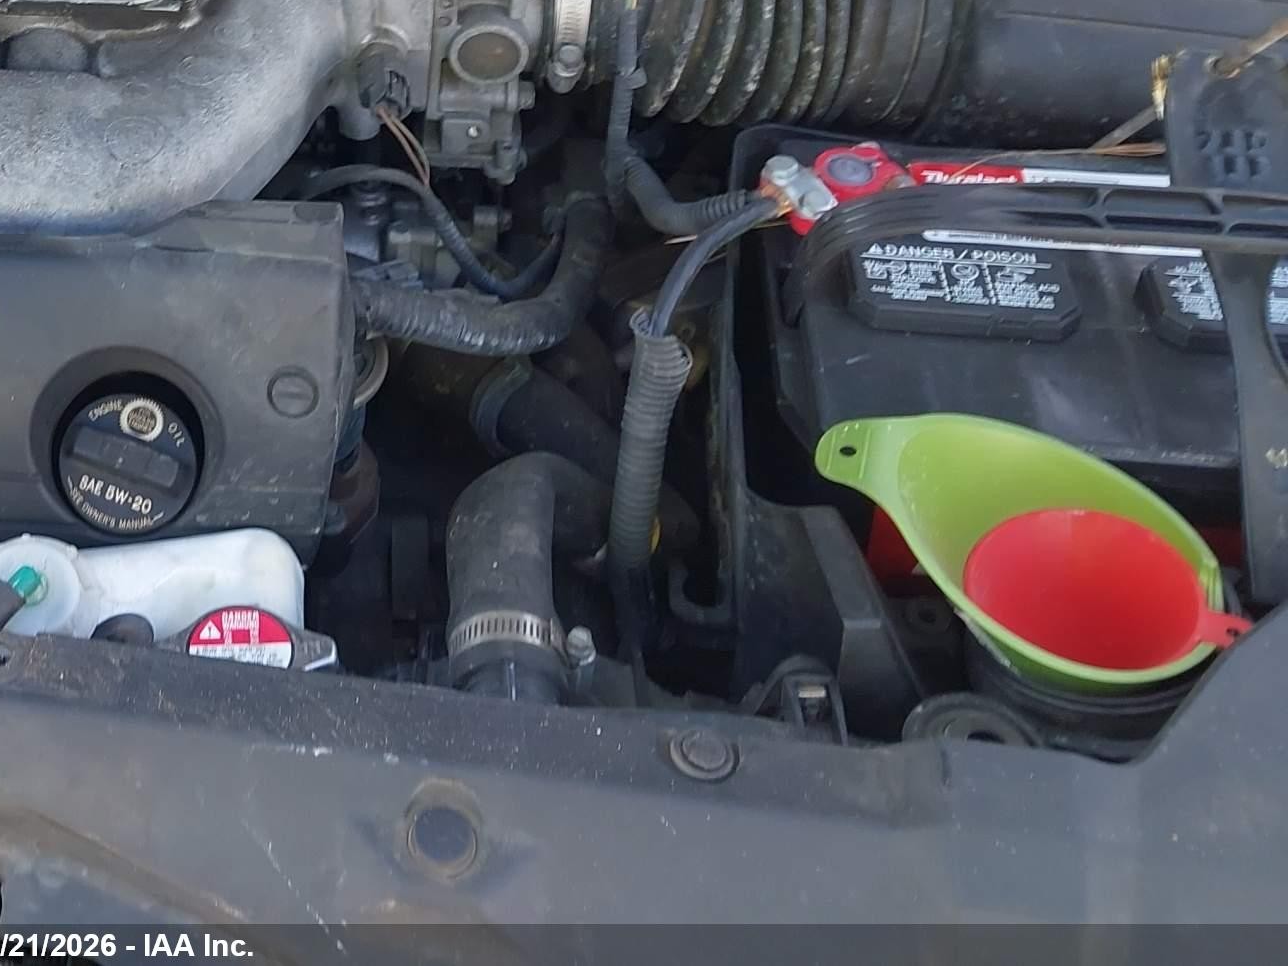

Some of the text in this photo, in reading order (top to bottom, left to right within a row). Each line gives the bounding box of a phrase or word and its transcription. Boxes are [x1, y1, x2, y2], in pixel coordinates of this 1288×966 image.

[884, 243, 955, 260] DANGER
[970, 249, 1037, 264] POISON
[88, 399, 123, 422] ENGINE
[167, 422, 185, 448] OIL
[79, 474, 103, 497] SAE
[118, 516, 154, 530] MANUAL
